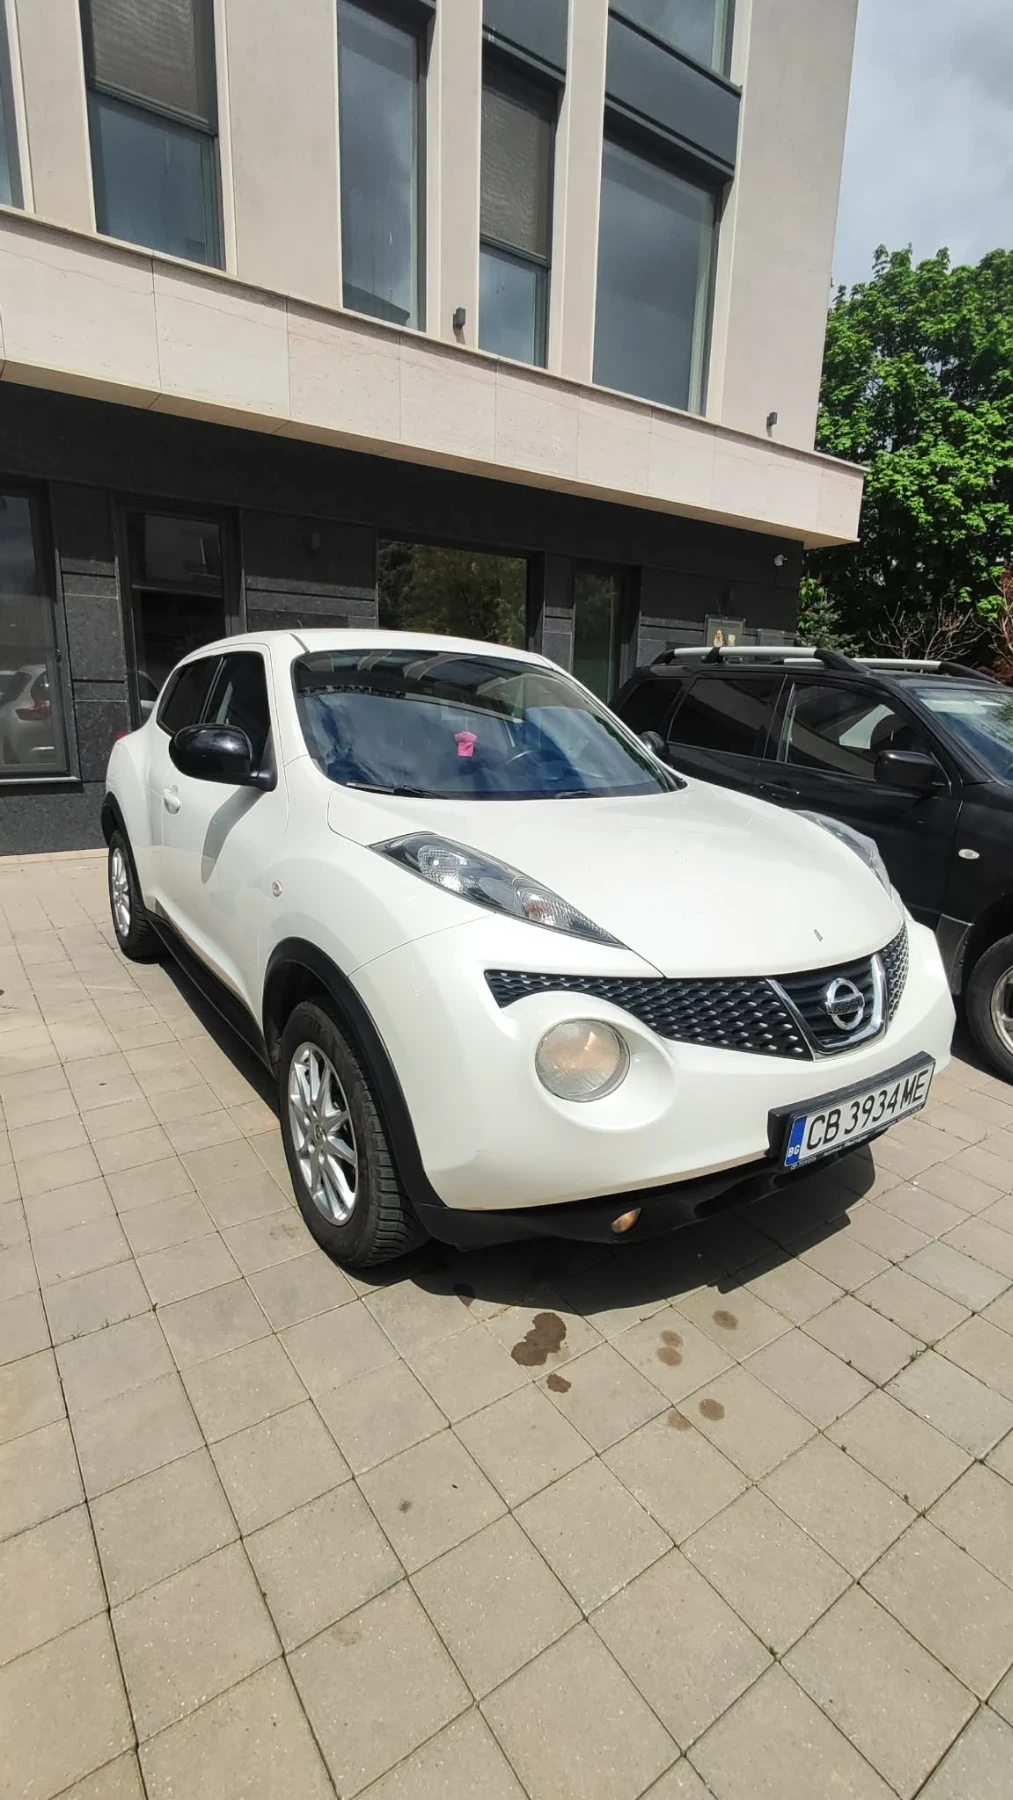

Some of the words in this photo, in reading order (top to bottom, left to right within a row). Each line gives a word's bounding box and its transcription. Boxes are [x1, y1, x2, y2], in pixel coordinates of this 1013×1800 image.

[806, 1108, 841, 1150] CB
[844, 1082, 901, 1135] 3934
[787, 1144, 801, 1157] BG
